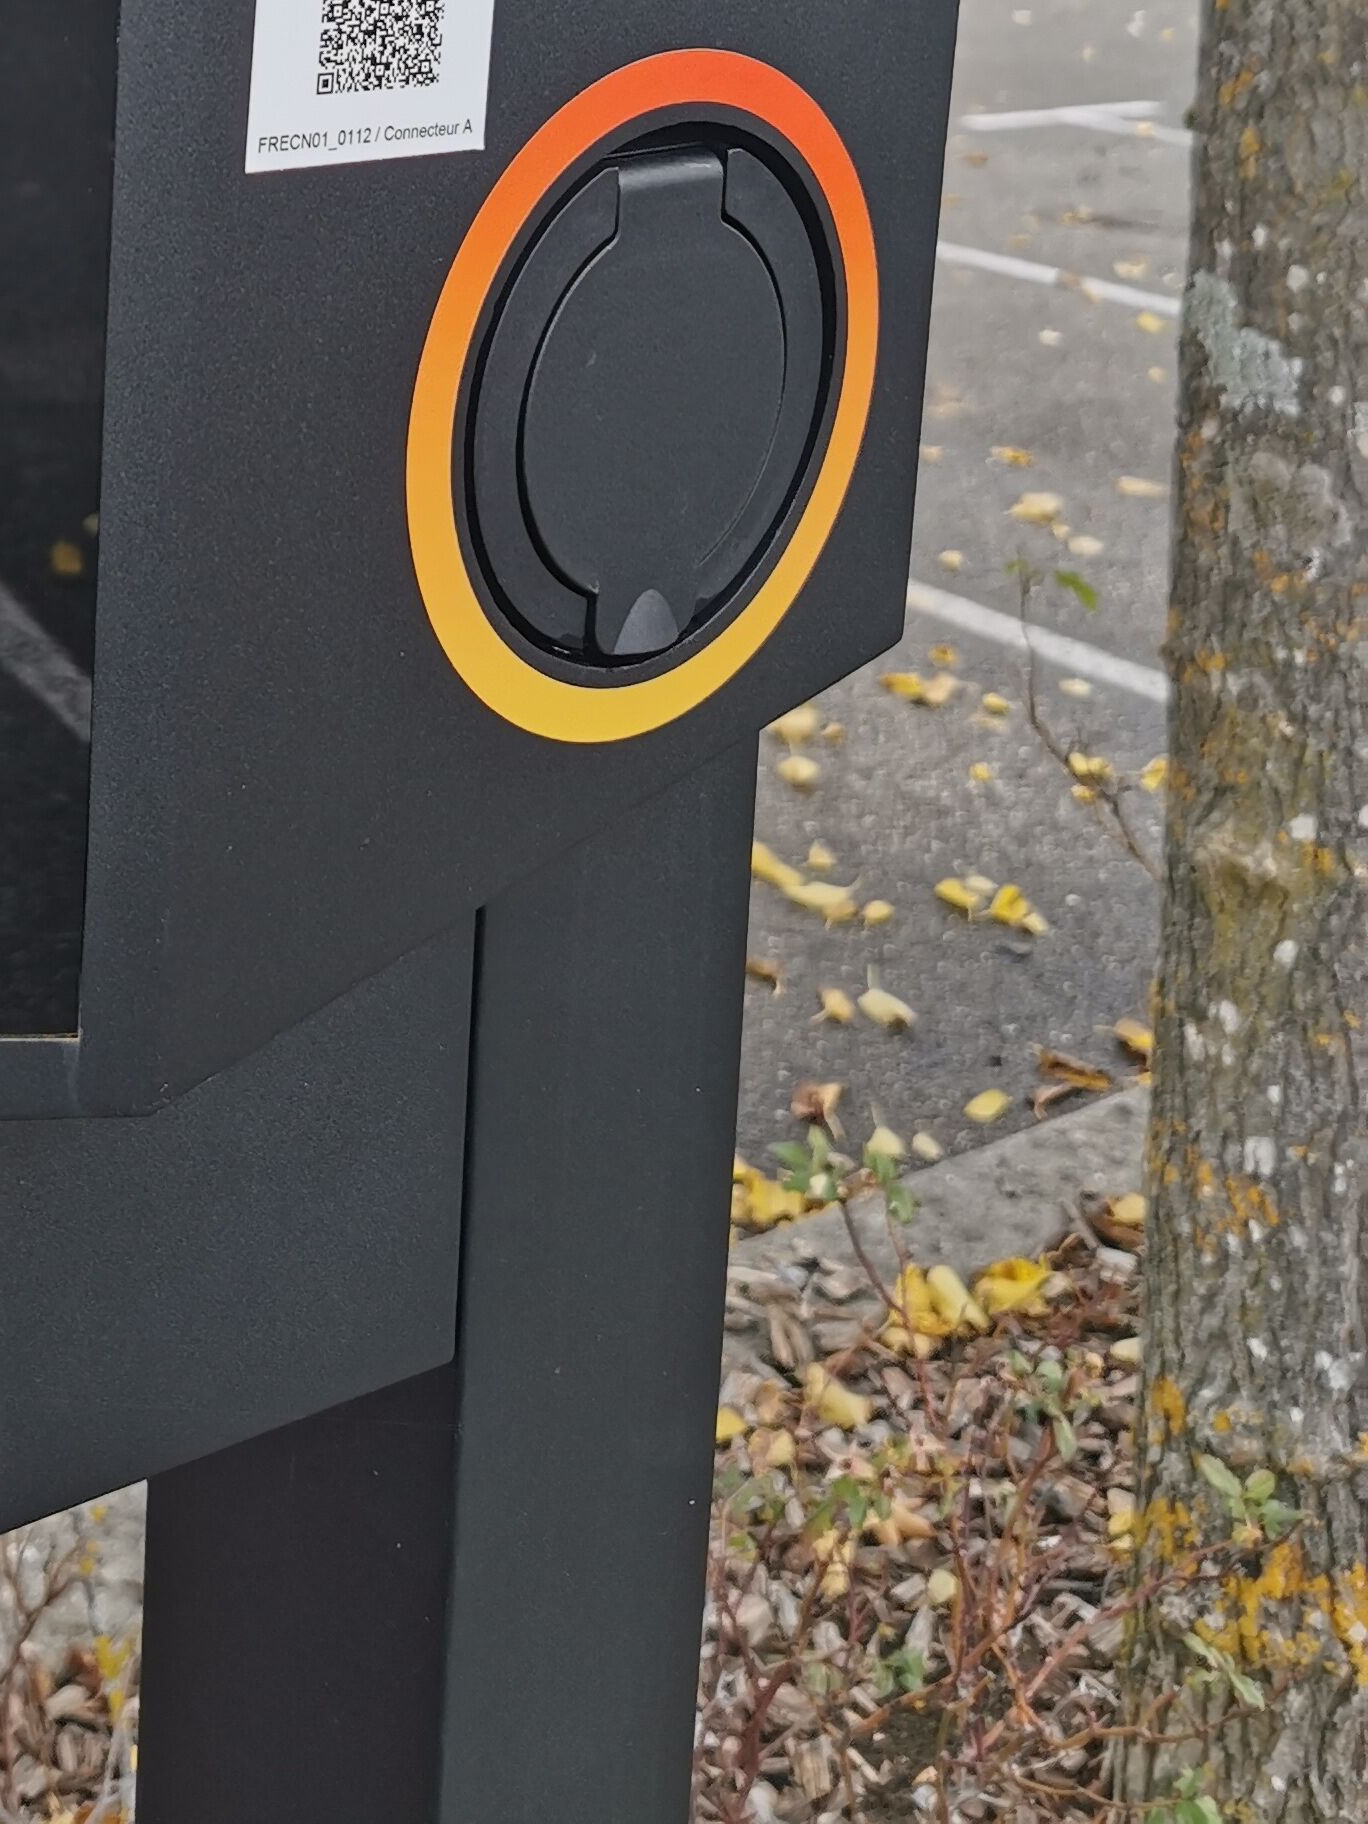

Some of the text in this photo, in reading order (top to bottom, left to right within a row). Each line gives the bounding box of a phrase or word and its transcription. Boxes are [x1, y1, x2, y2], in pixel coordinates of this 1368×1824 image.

[258, 128, 371, 153] FRECN01_0112
[384, 122, 461, 141] Connecteur
[462, 118, 473, 134] A
